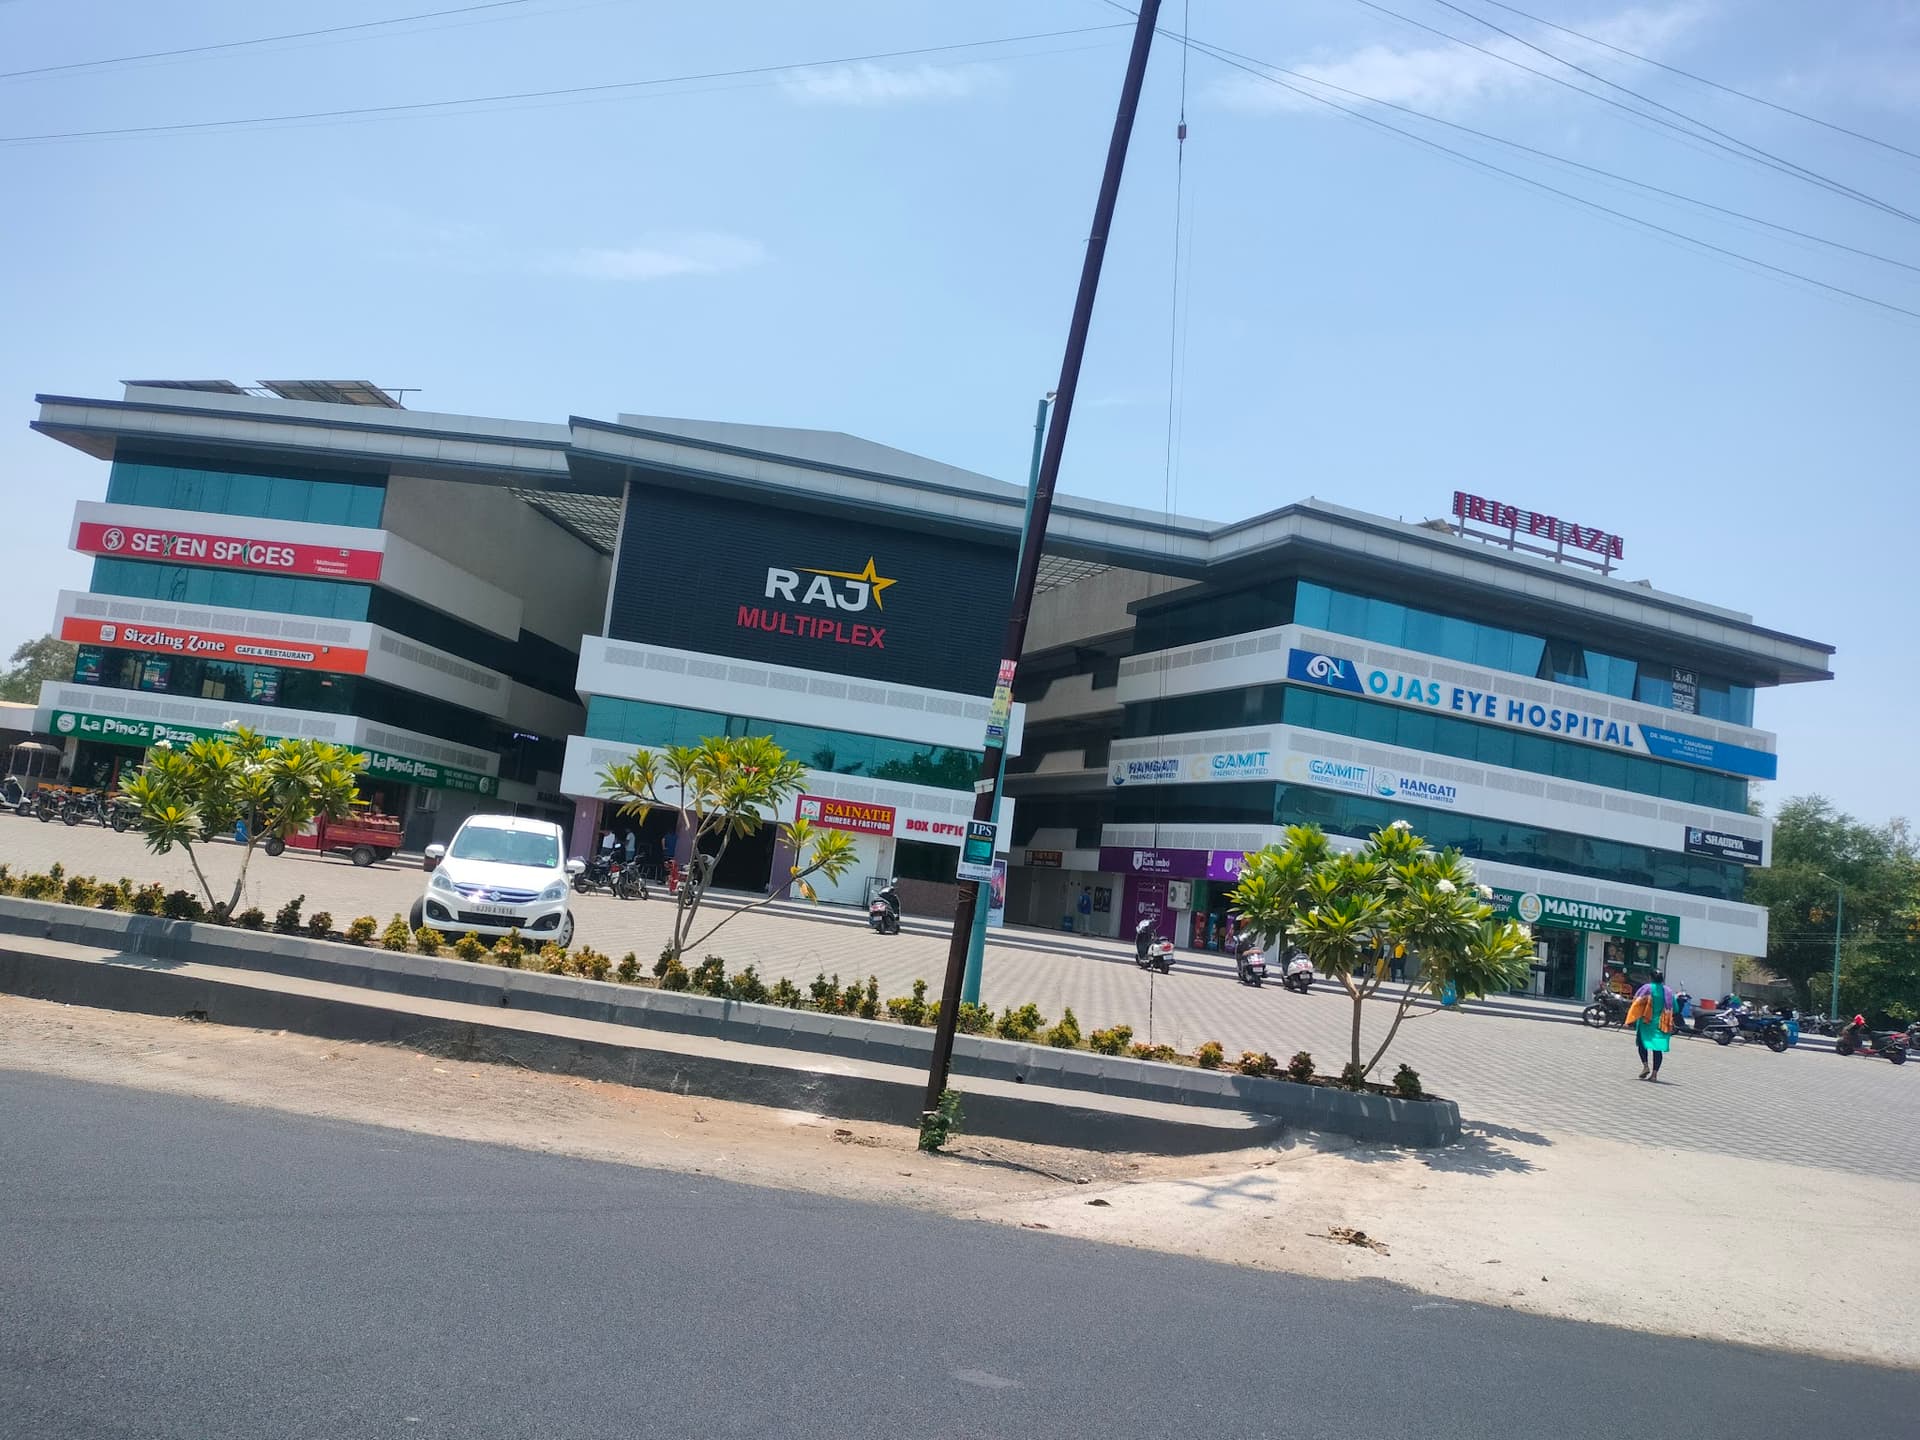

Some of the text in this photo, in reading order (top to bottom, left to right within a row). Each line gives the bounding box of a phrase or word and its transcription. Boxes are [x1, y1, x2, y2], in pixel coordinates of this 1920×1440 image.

[1454, 491, 1623, 560] IRIS PLAZA
[131, 533, 207, 557] SEVEN
[213, 540, 295, 567] SPICES
[765, 567, 869, 611] RAJ
[737, 605, 886, 648] MULTIPLEX
[124, 628, 225, 651] Sizzling Zone
[237, 646, 254, 654] CAFE
[265, 649, 311, 660] RESTAURANT
[1368, 670, 1441, 706] OJAS
[1452, 687, 1497, 718] EYE
[1507, 700, 1634, 747] HOSPITAL
[80, 716, 197, 742] La Pino'z Pizza
[372, 753, 386, 768] La
[413, 762, 437, 778] Pizza
[1212, 751, 1270, 769] GAMIT
[1309, 759, 1368, 781] GAMIT
[1400, 777, 1456, 798] HANGATI
[1402, 789, 1454, 803] FINANCE LIMITED
[824, 815, 851, 826] CHINESE
[858, 820, 891, 831] FASTFOOD
[825, 803, 892, 822] SAINATH
[906, 819, 964, 837] BOX OFFIC
[972, 823, 993, 836] IPS
[1705, 834, 1744, 850] SHAURYA
[1493, 894, 1513, 904] HOME
[1544, 899, 1627, 925] MARTINO'Z
[1572, 920, 1601, 930] PIZZA
